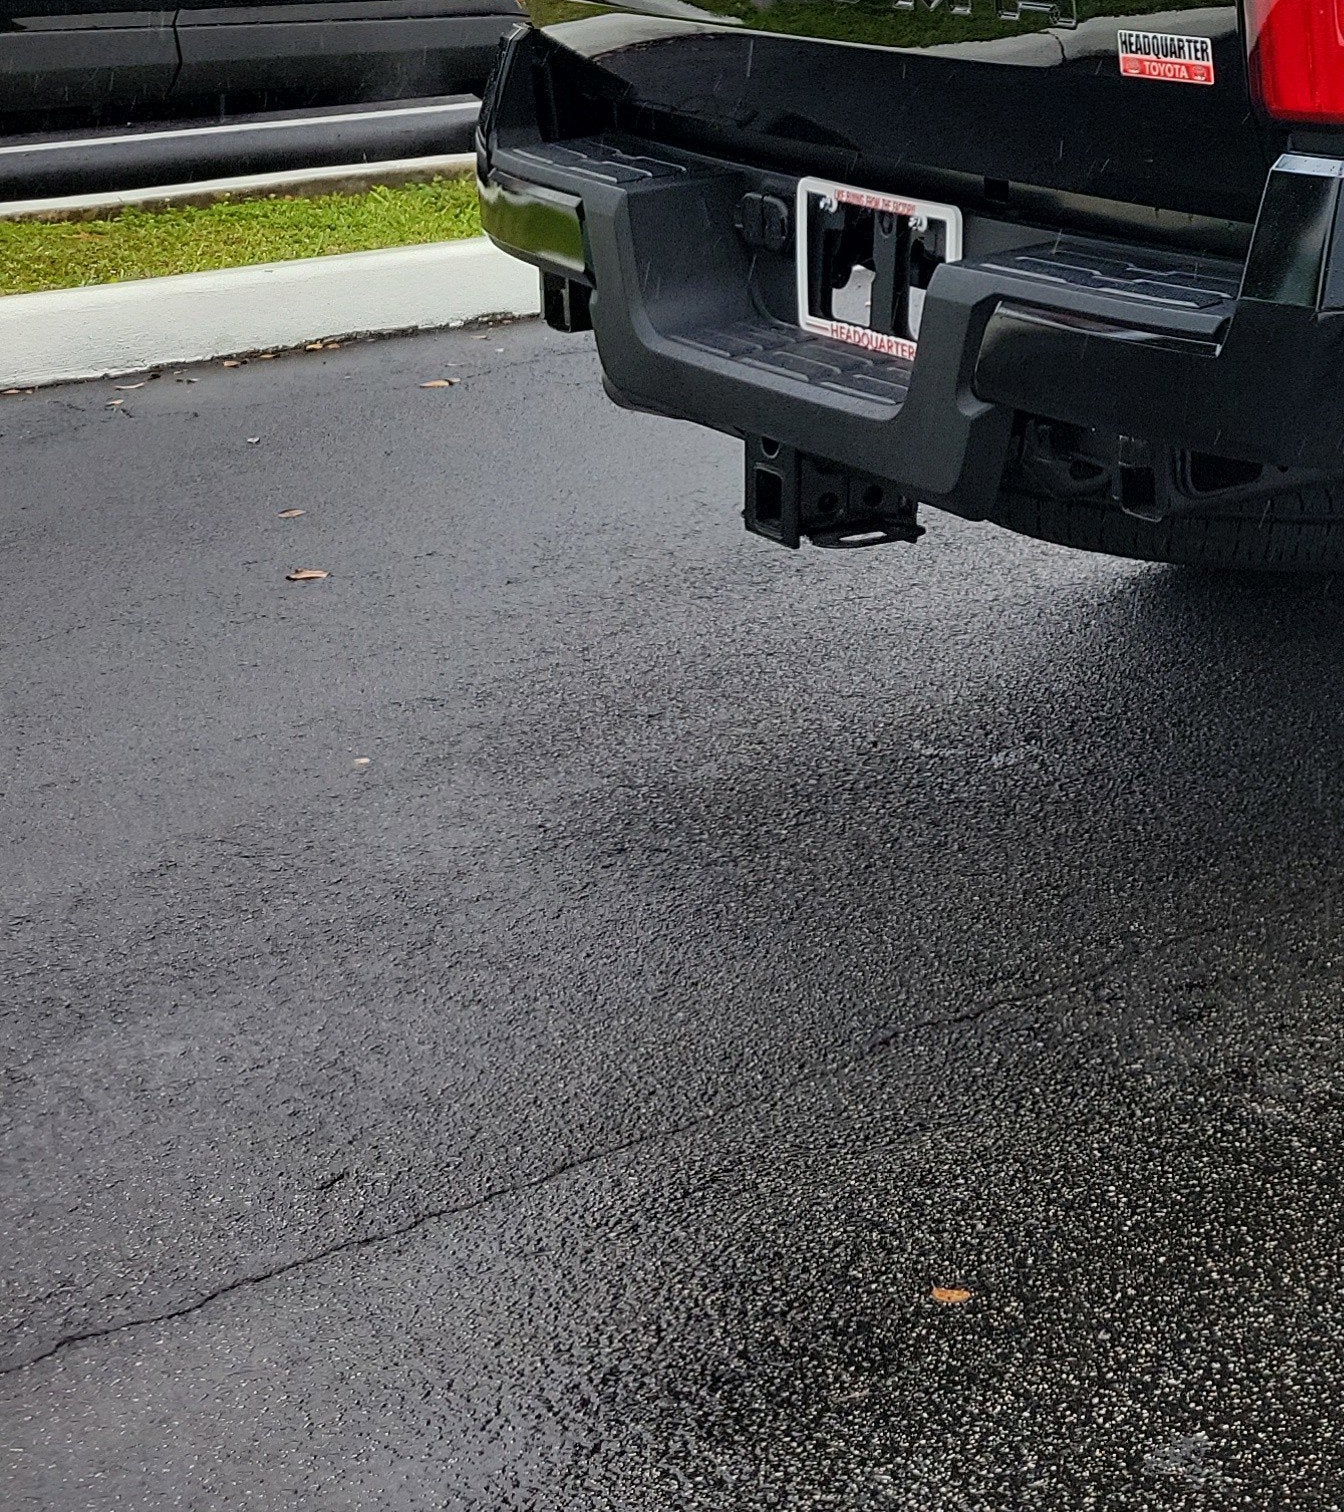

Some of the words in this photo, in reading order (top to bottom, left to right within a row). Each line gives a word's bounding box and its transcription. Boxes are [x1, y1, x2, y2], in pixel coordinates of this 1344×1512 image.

[1119, 31, 1210, 63] HEADQUARTER
[1142, 61, 1189, 79] TOYOTA
[830, 322, 917, 359] HEADQUARTER
